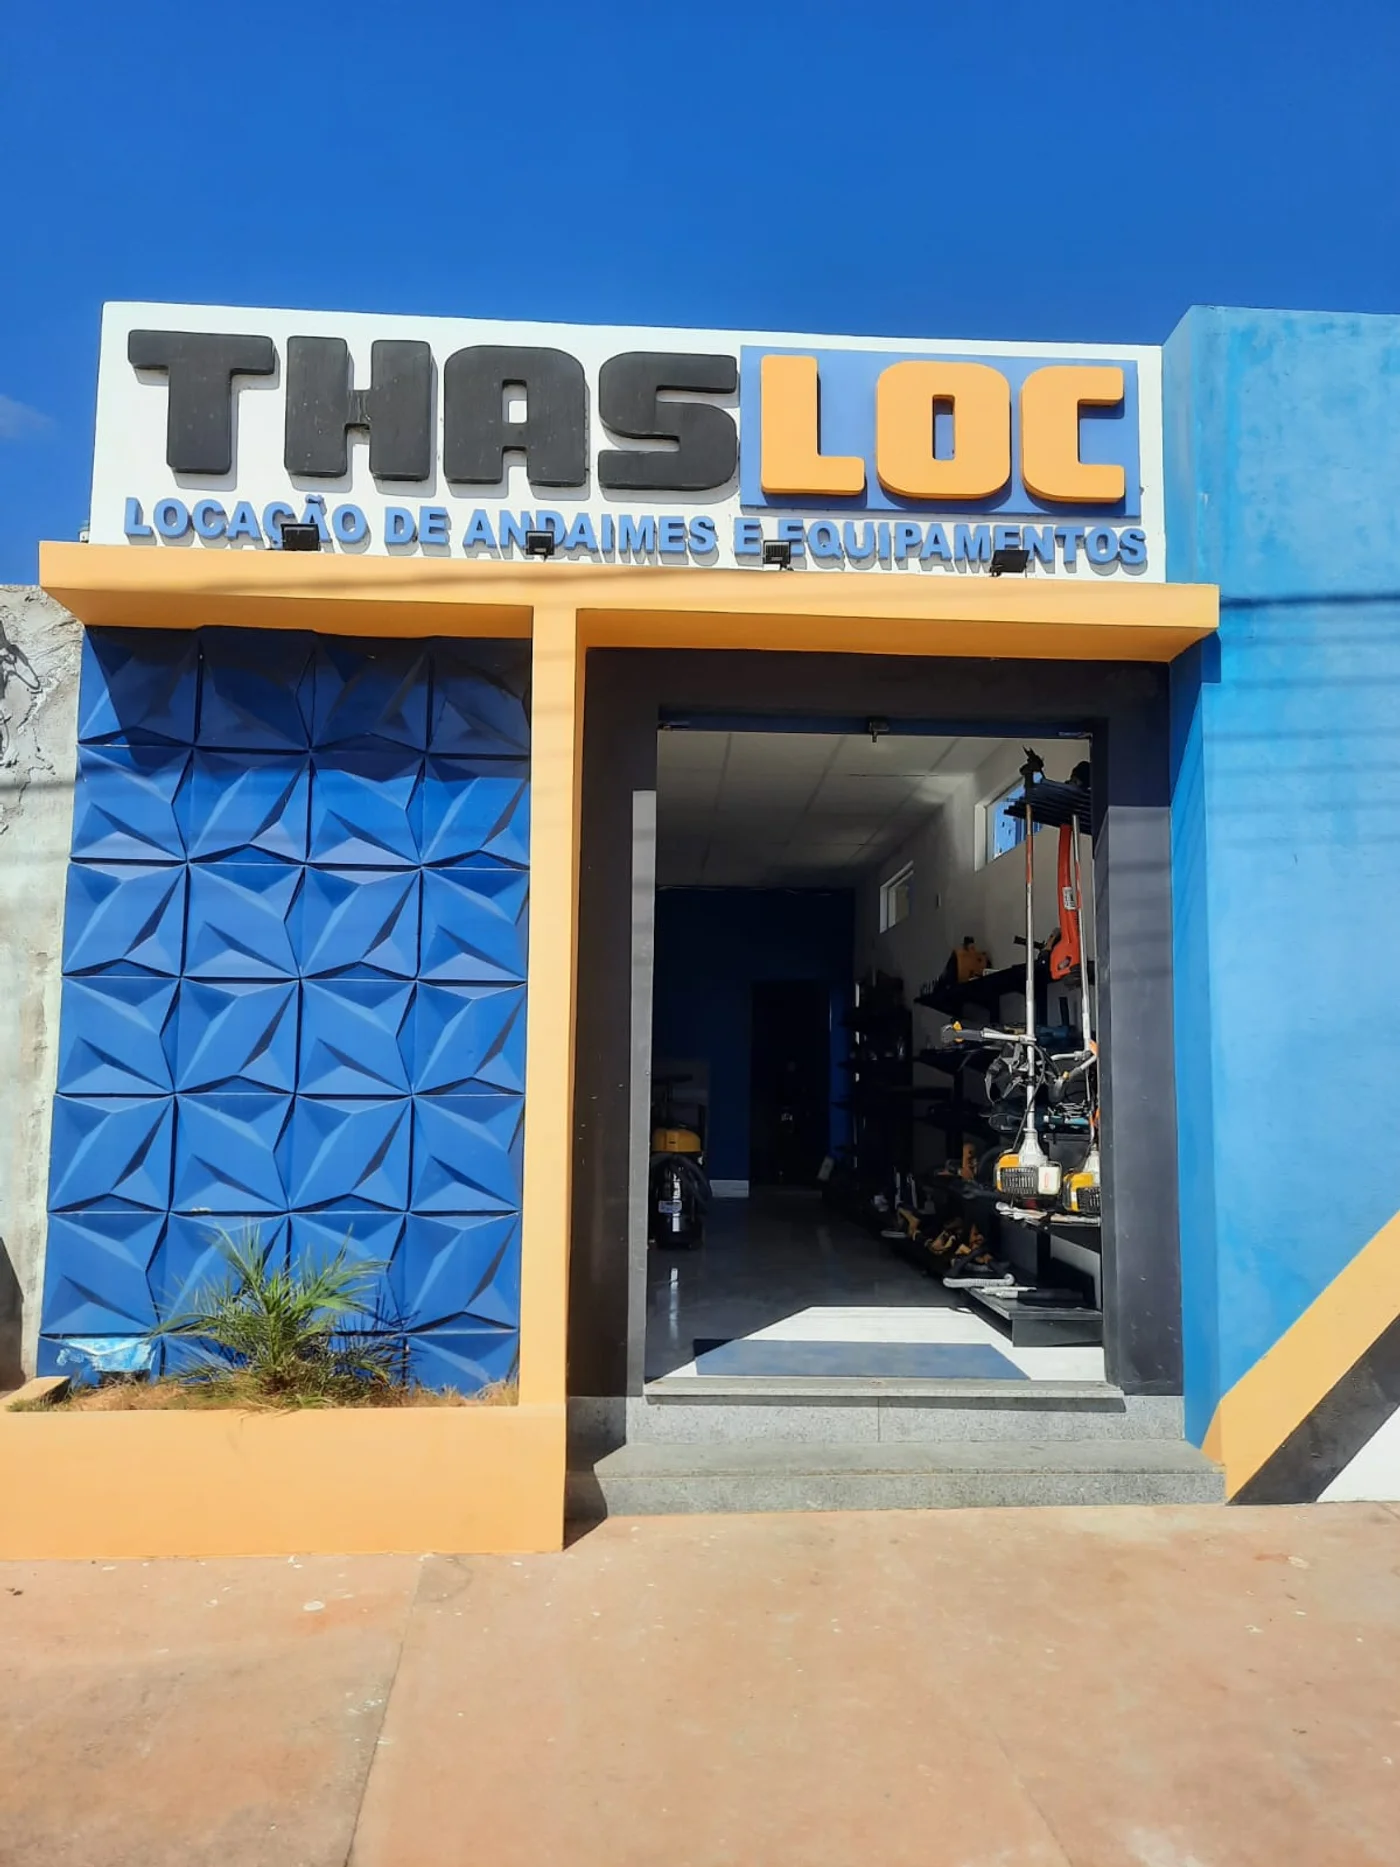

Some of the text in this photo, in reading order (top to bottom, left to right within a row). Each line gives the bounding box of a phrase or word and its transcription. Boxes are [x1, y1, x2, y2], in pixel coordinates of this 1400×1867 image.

[123, 494, 1148, 566] LOCAÇÃO DE ANDAIMES E EQUIPAMENTOS
